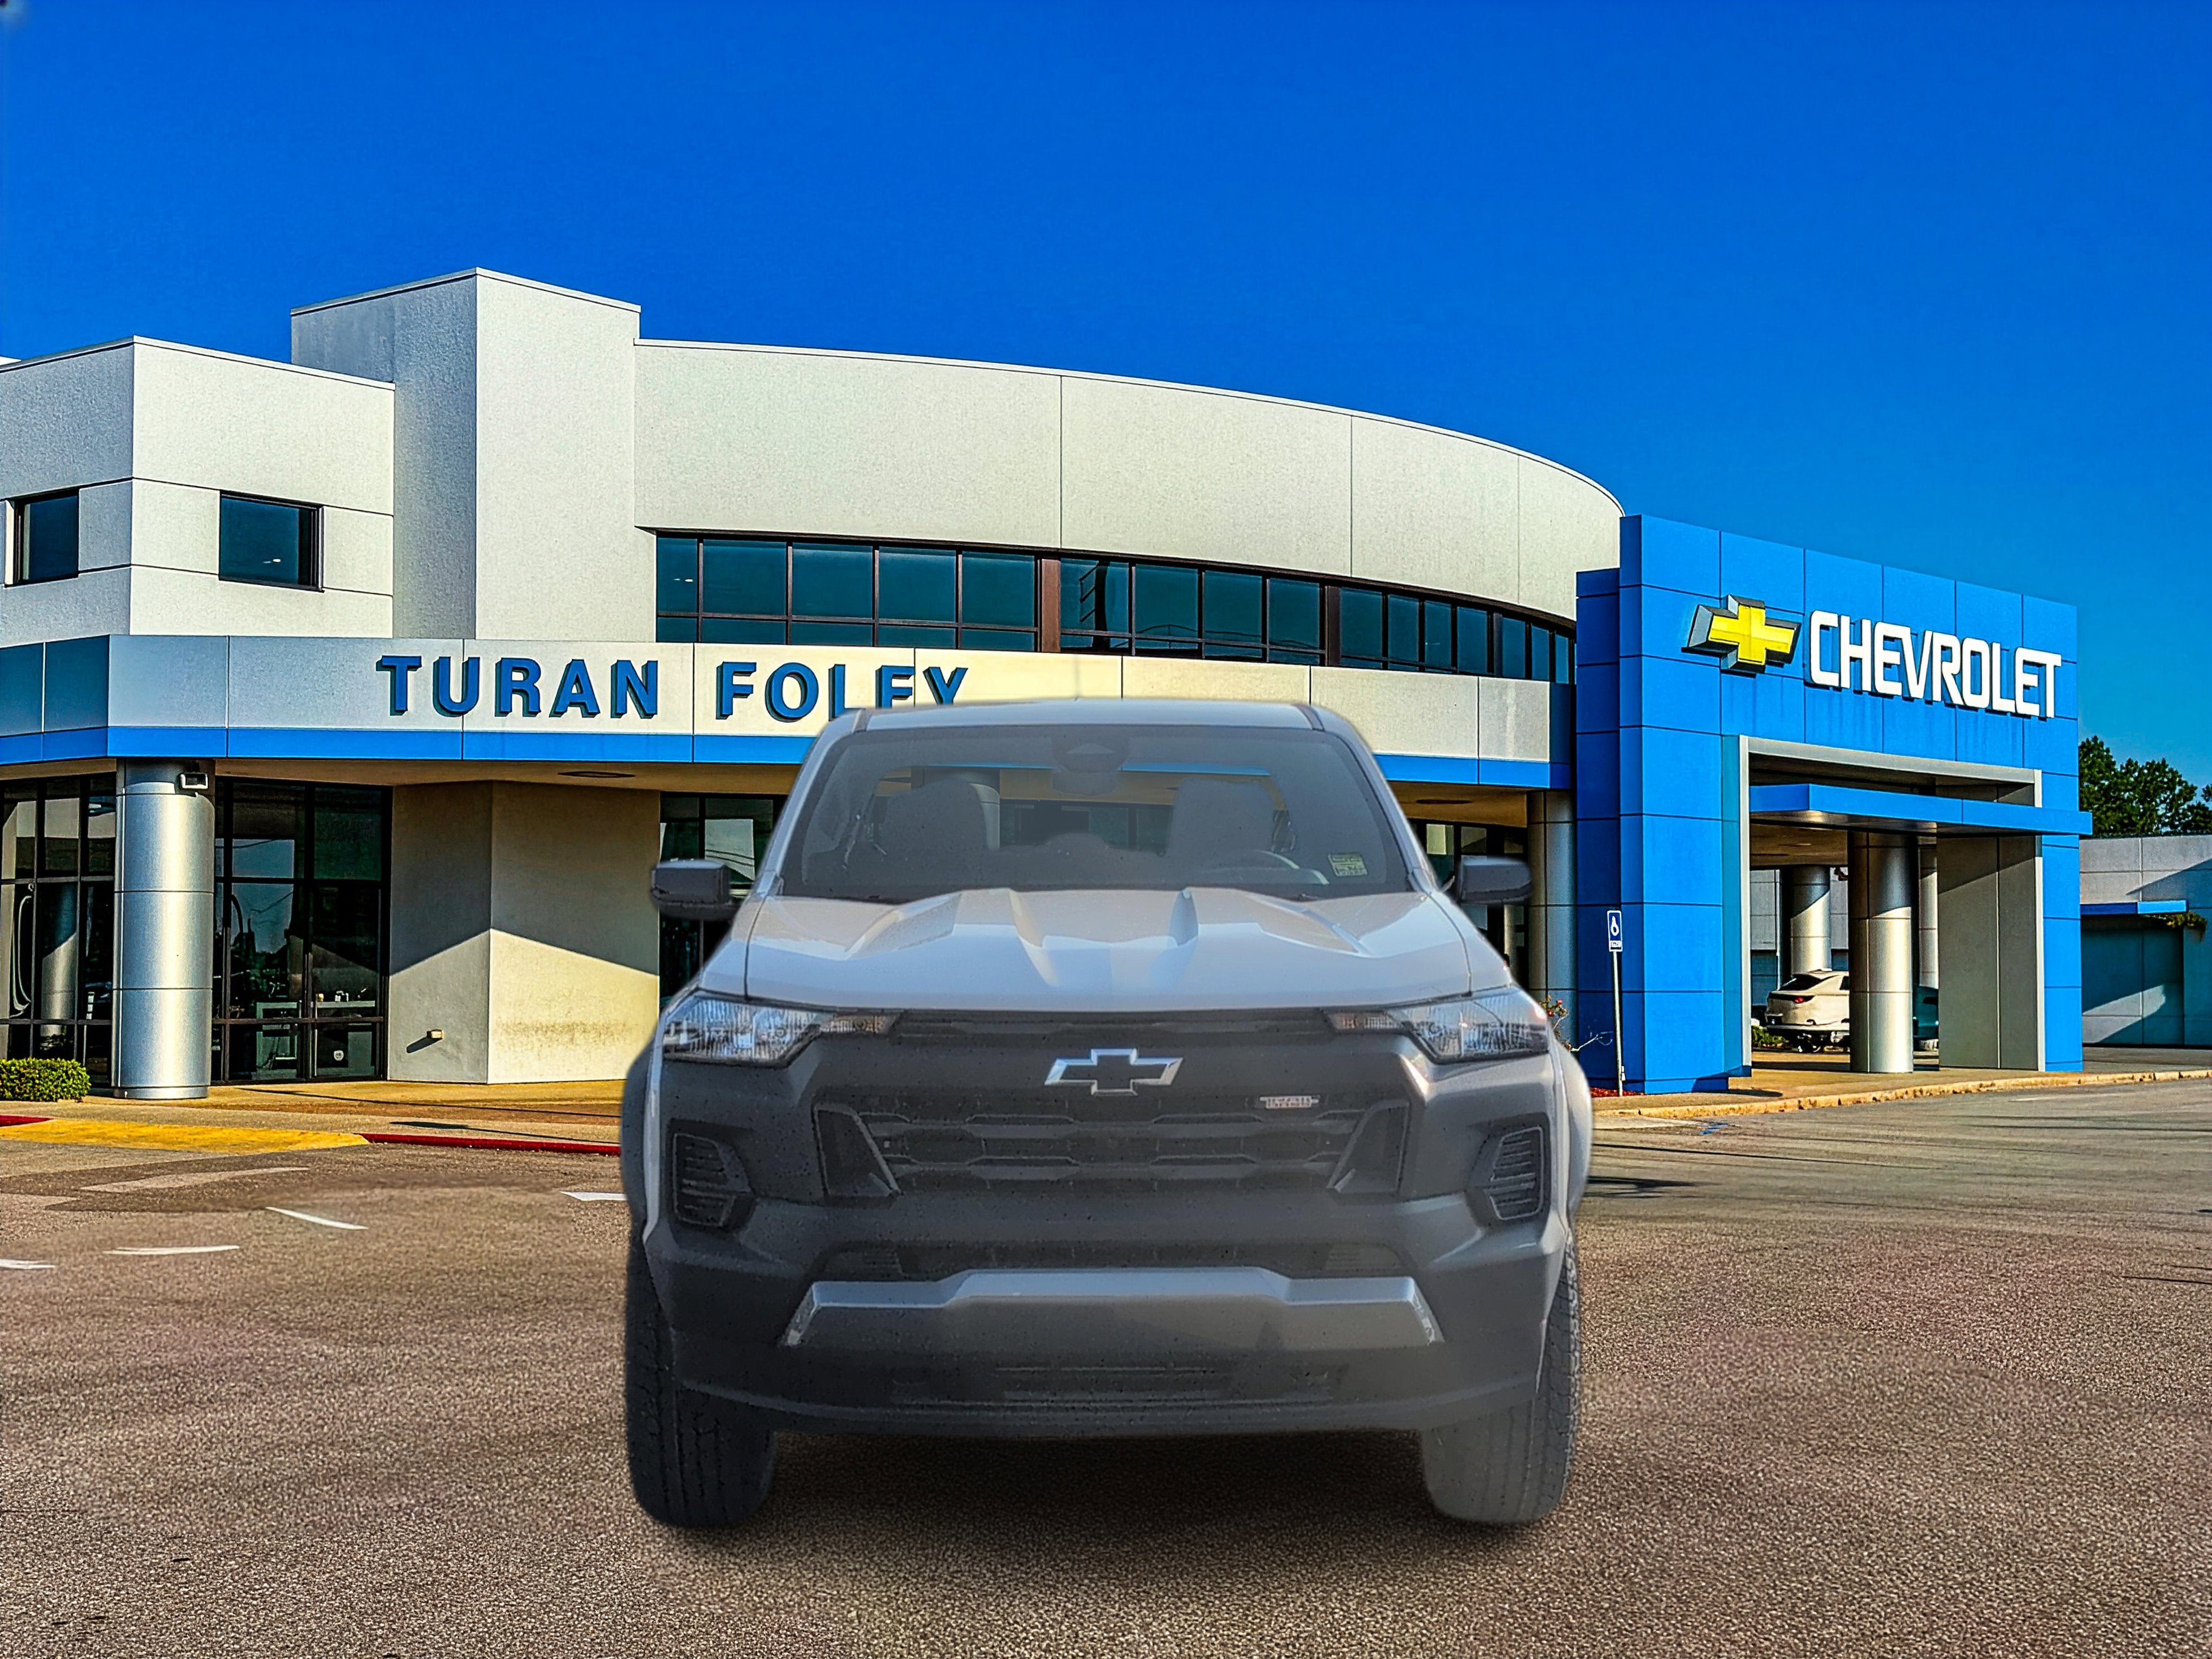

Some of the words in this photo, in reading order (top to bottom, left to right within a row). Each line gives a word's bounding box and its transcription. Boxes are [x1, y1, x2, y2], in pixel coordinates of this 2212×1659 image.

[376, 655, 659, 719] TURAN
[716, 661, 969, 723] FOLEY
[1809, 609, 2062, 718] CHEVROLET
